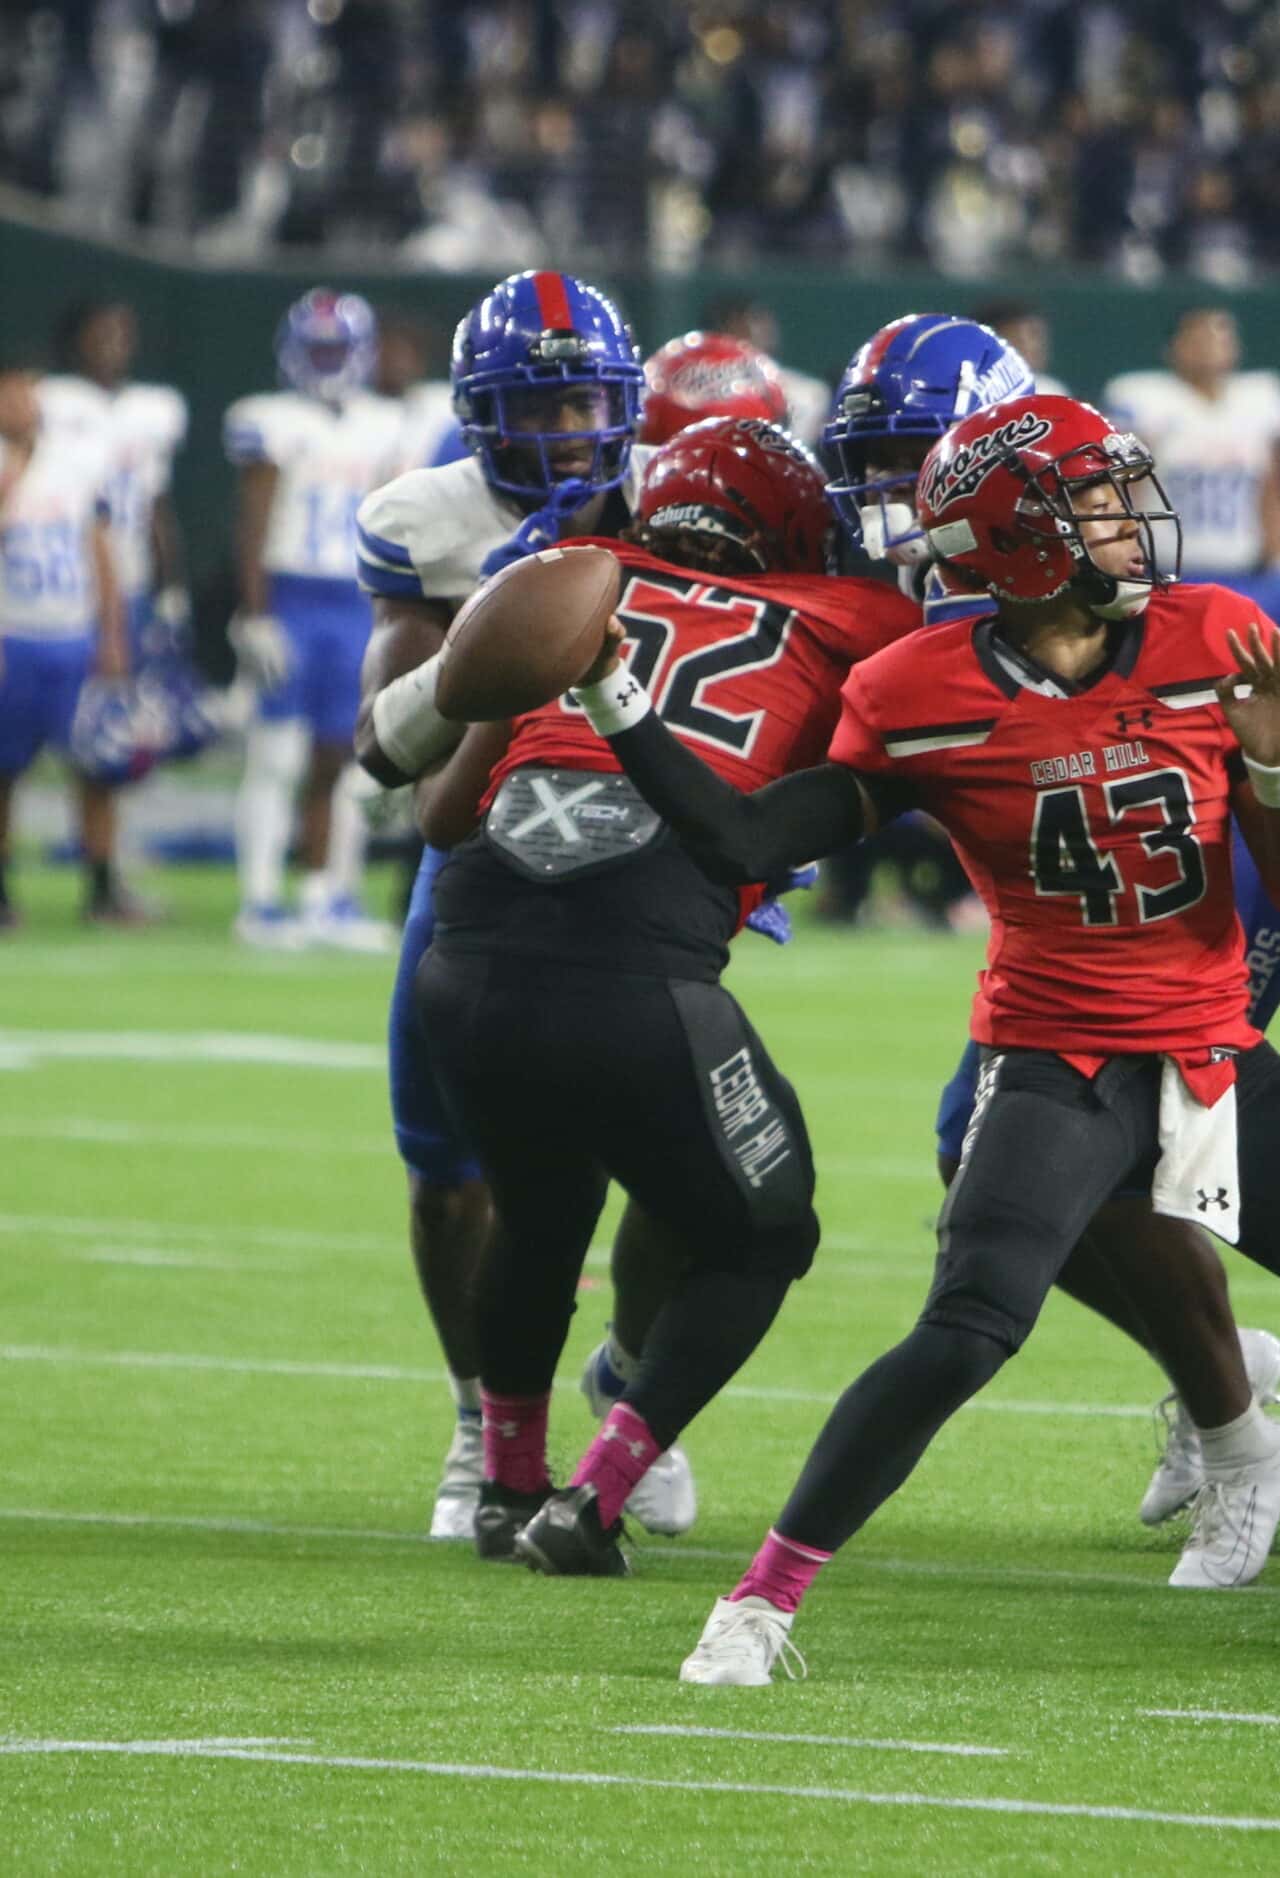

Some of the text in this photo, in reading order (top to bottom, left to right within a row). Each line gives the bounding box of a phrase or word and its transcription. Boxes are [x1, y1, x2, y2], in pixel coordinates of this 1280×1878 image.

[919, 412, 1052, 517] Horns
[1030, 740, 1150, 786] CEDAR HILL
[1028, 766, 1208, 927] 43
[710, 1047, 791, 1188] CEDAR HILL
